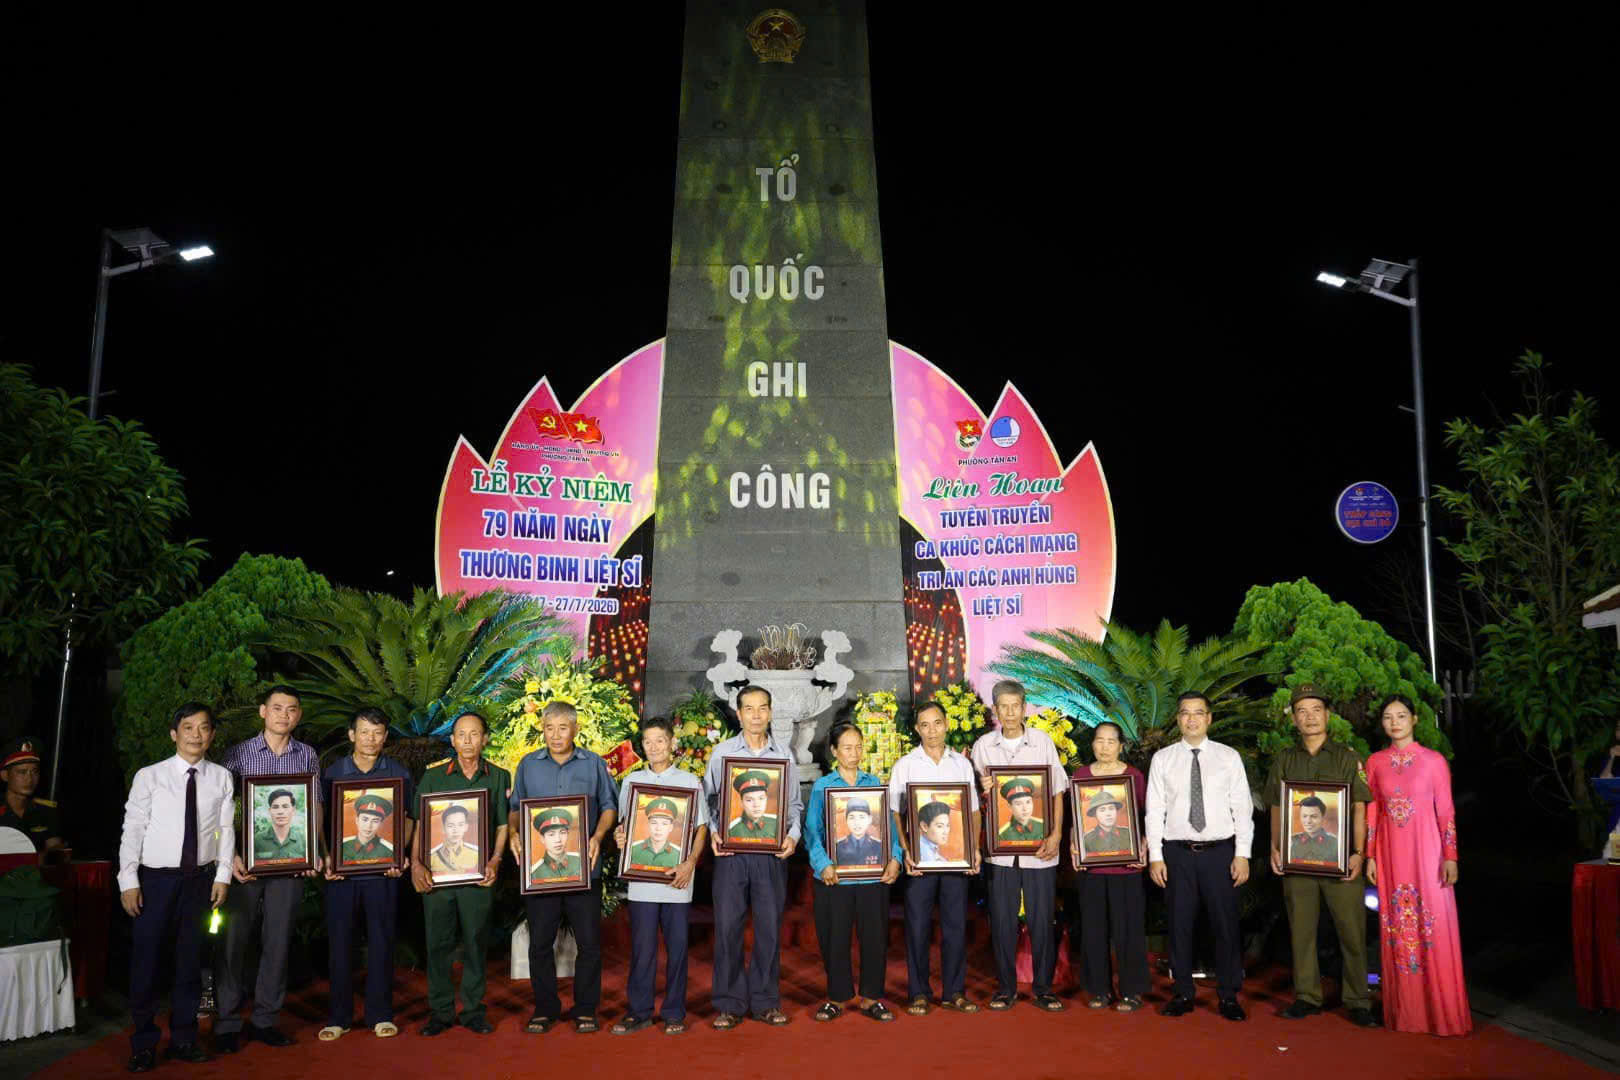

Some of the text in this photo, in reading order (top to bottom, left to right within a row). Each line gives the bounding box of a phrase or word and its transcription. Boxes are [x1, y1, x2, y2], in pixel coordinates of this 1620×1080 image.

[755, 153, 800, 202] TỔ
[729, 253, 825, 304] QUỐC
[747, 361, 808, 397] GHI
[472, 460, 633, 508] LỄ KỶ NIỆM
[729, 464, 831, 509] CÔNG
[922, 472, 1064, 500] Liên Hoan
[483, 508, 612, 544] 79 NĂM NGÀY
[939, 500, 1050, 529] TUYÊN TRUYỀN
[915, 533, 1077, 559] CA KHÚC CÁCH MẠNG
[460, 550, 643, 590] THƯƠNG BINH LIỆT SĨ
[918, 571, 941, 590] TRI
[968, 566, 997, 588] CÁC
[1001, 569, 1031, 586] ANH
[1035, 563, 1076, 585] HÙNG
[555, 597, 618, 614] 27/7/2026)
[973, 593, 1022, 619] LIỆT SĨ
